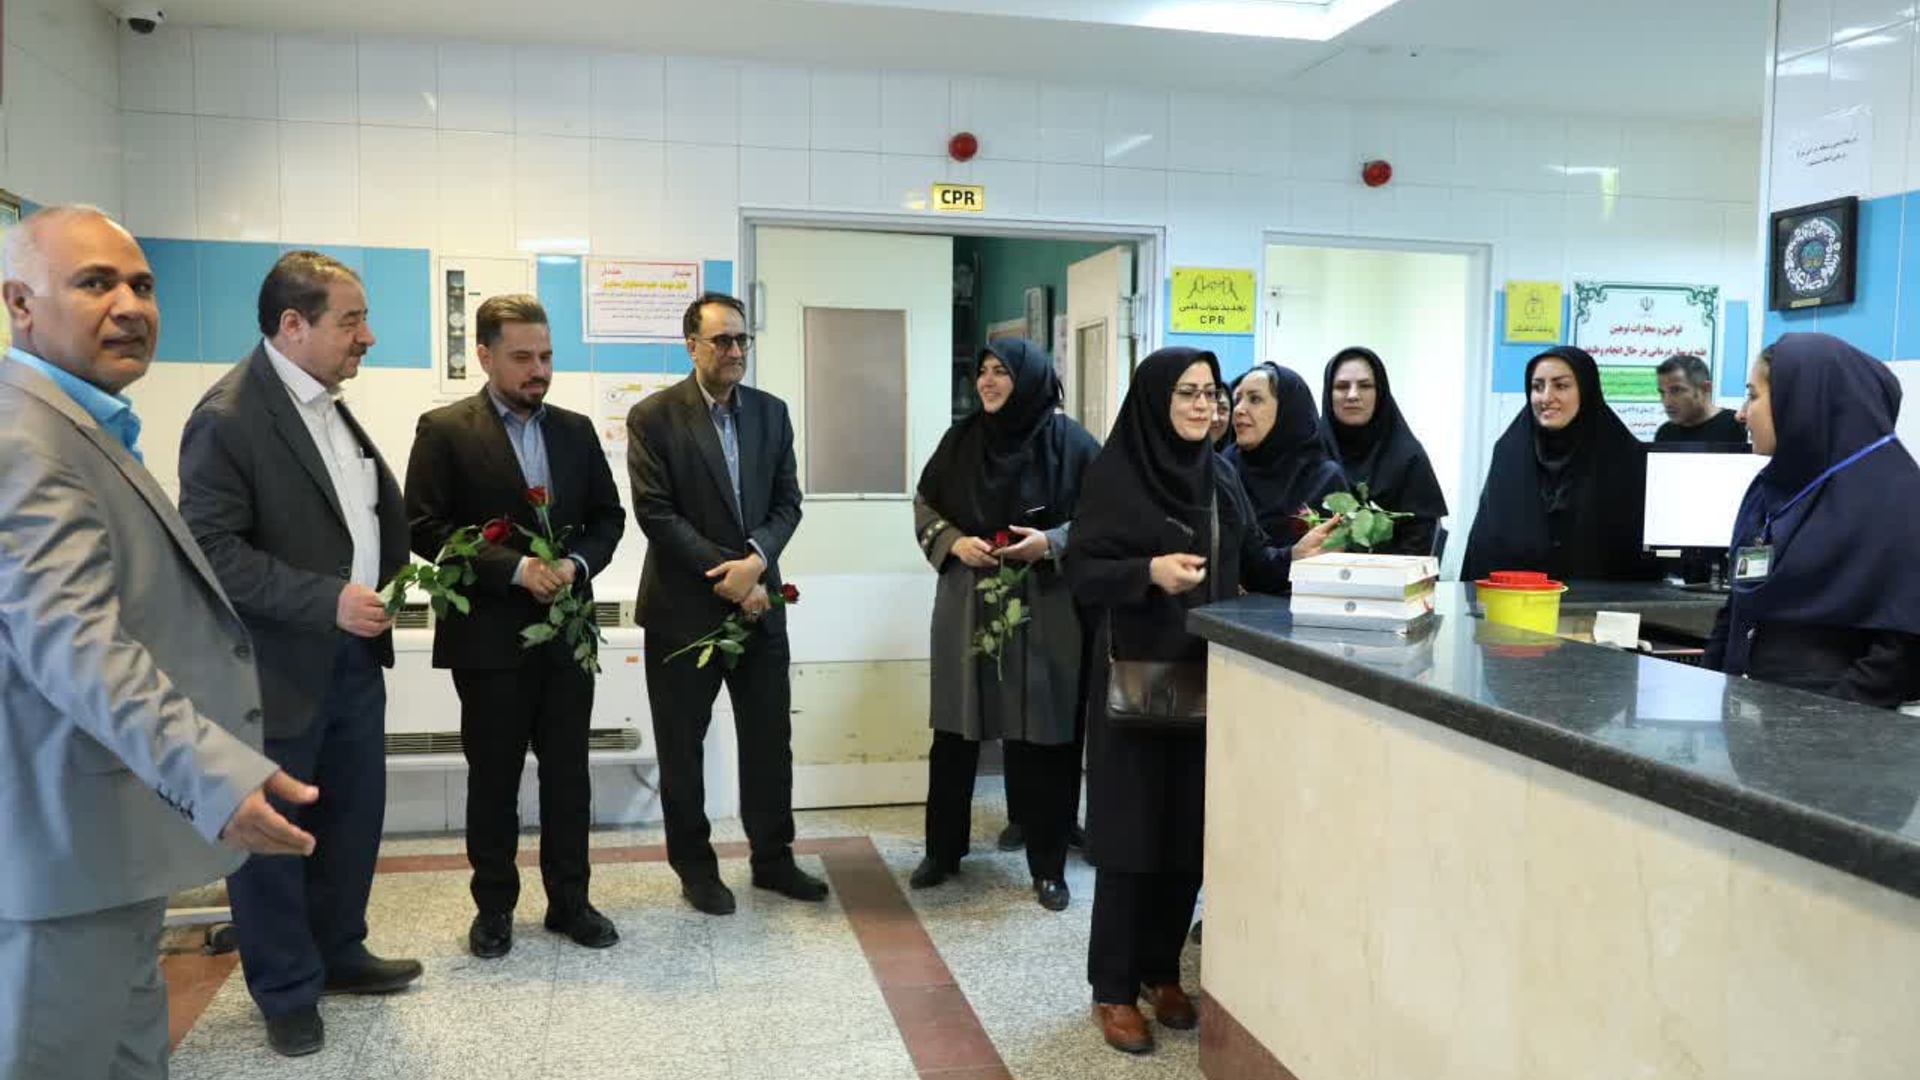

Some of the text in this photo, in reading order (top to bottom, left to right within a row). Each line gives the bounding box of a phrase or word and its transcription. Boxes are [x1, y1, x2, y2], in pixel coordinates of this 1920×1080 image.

[941, 189, 975, 206] CPR
[1200, 315, 1226, 325] CPR
[1609, 323, 1630, 335] توهین
[1631, 324, 1656, 335] مجازات
[1662, 324, 1683, 335] قوانین
[1605, 345, 1623, 355] انجام
[1623, 346, 1638, 357] حال
[1649, 346, 1673, 357] درمانی
